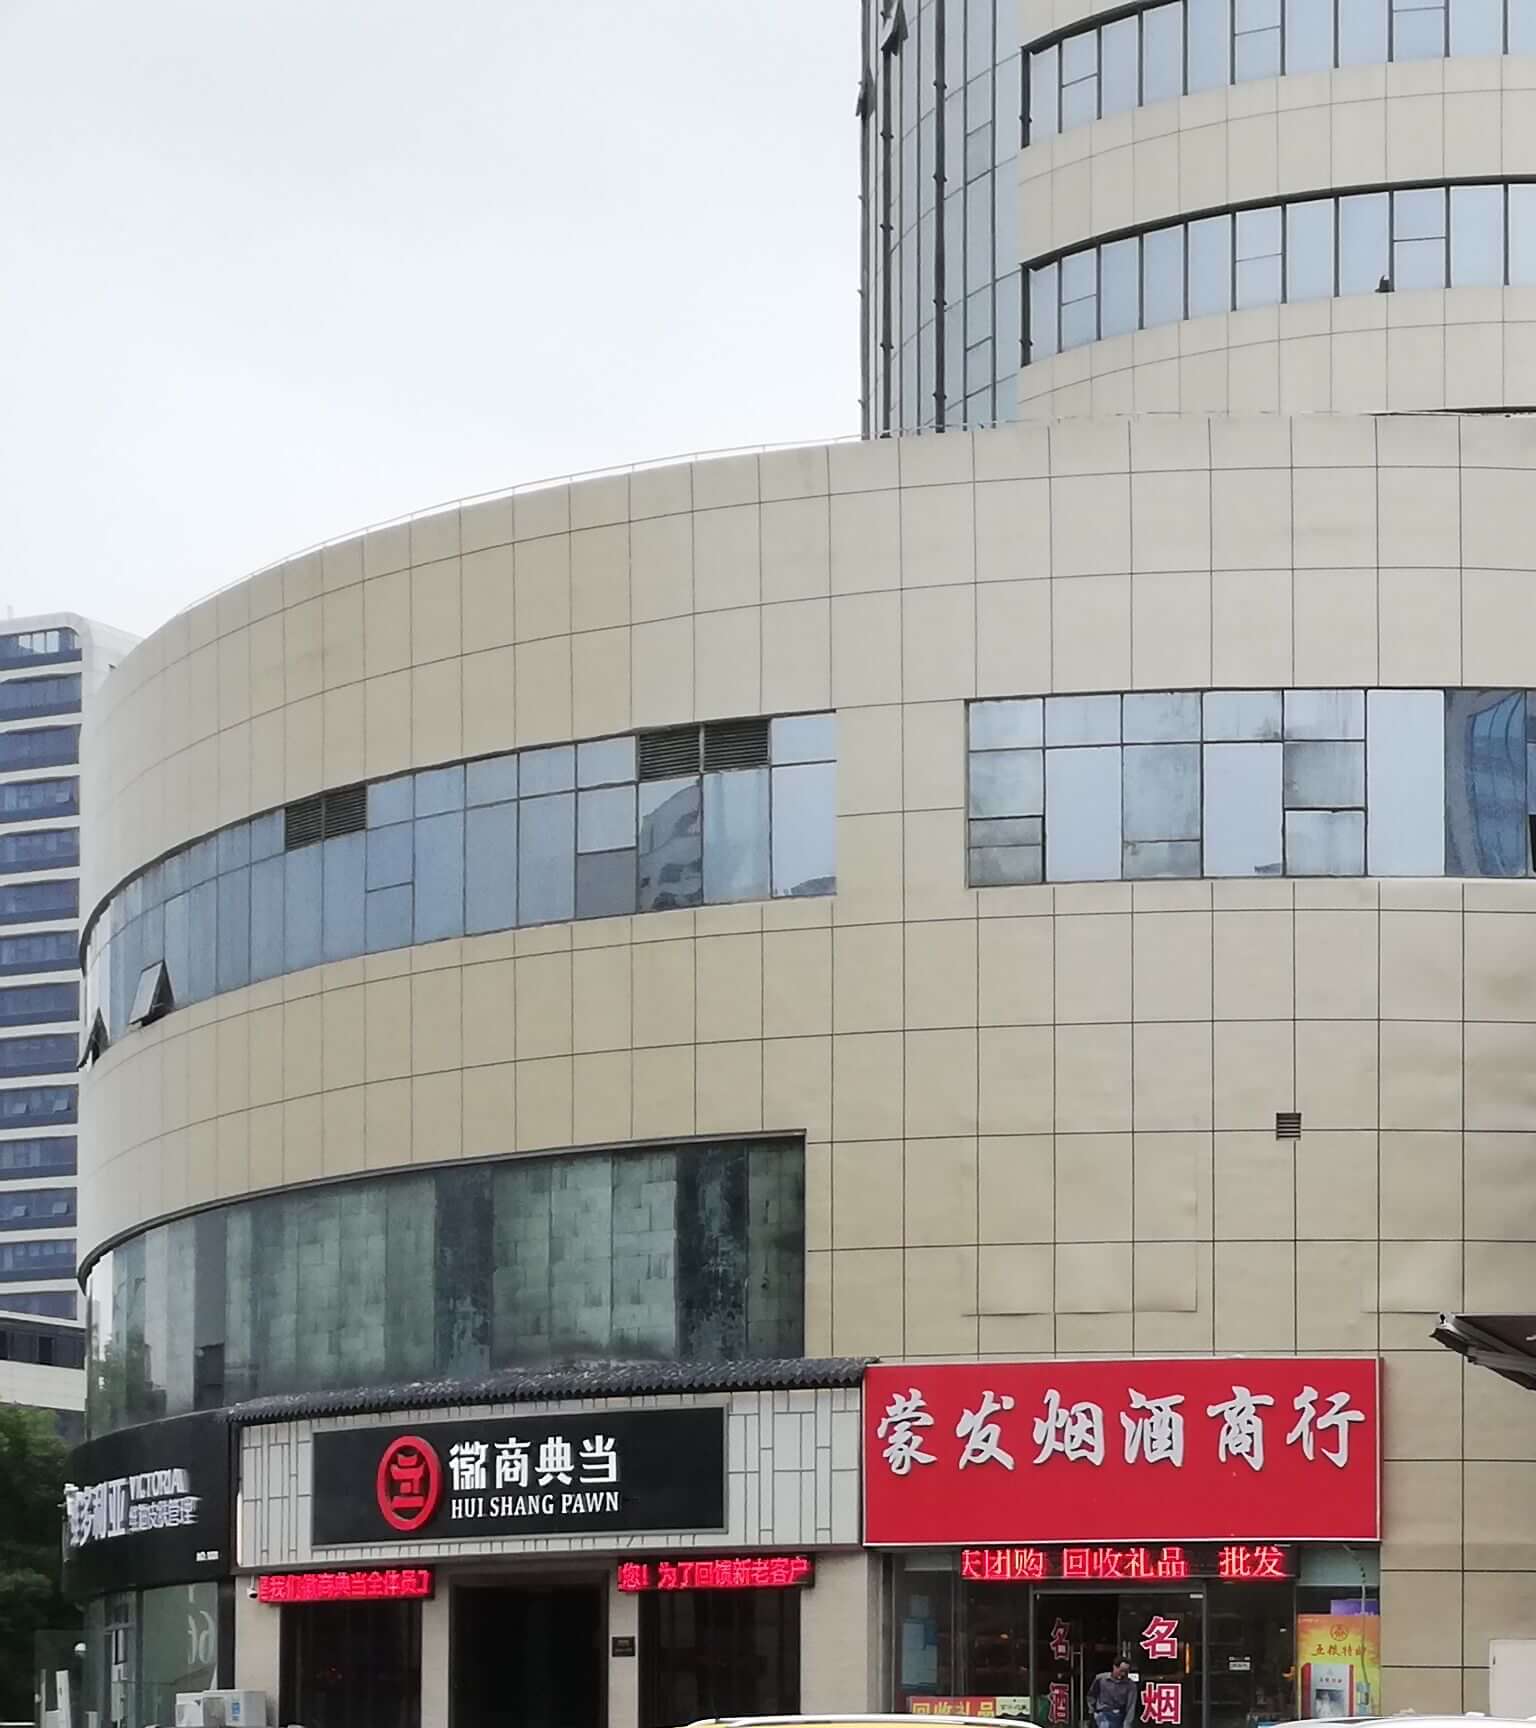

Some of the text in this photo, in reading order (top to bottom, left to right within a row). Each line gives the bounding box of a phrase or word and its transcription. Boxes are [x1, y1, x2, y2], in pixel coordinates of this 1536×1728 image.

[877, 1386, 1367, 1476] 蒙发烟酒商行
[450, 1491, 620, 1519] HUI SHANG PAWN
[1063, 1547, 1188, 1577] 回收礼品
[1219, 1546, 1285, 1577] 批发
